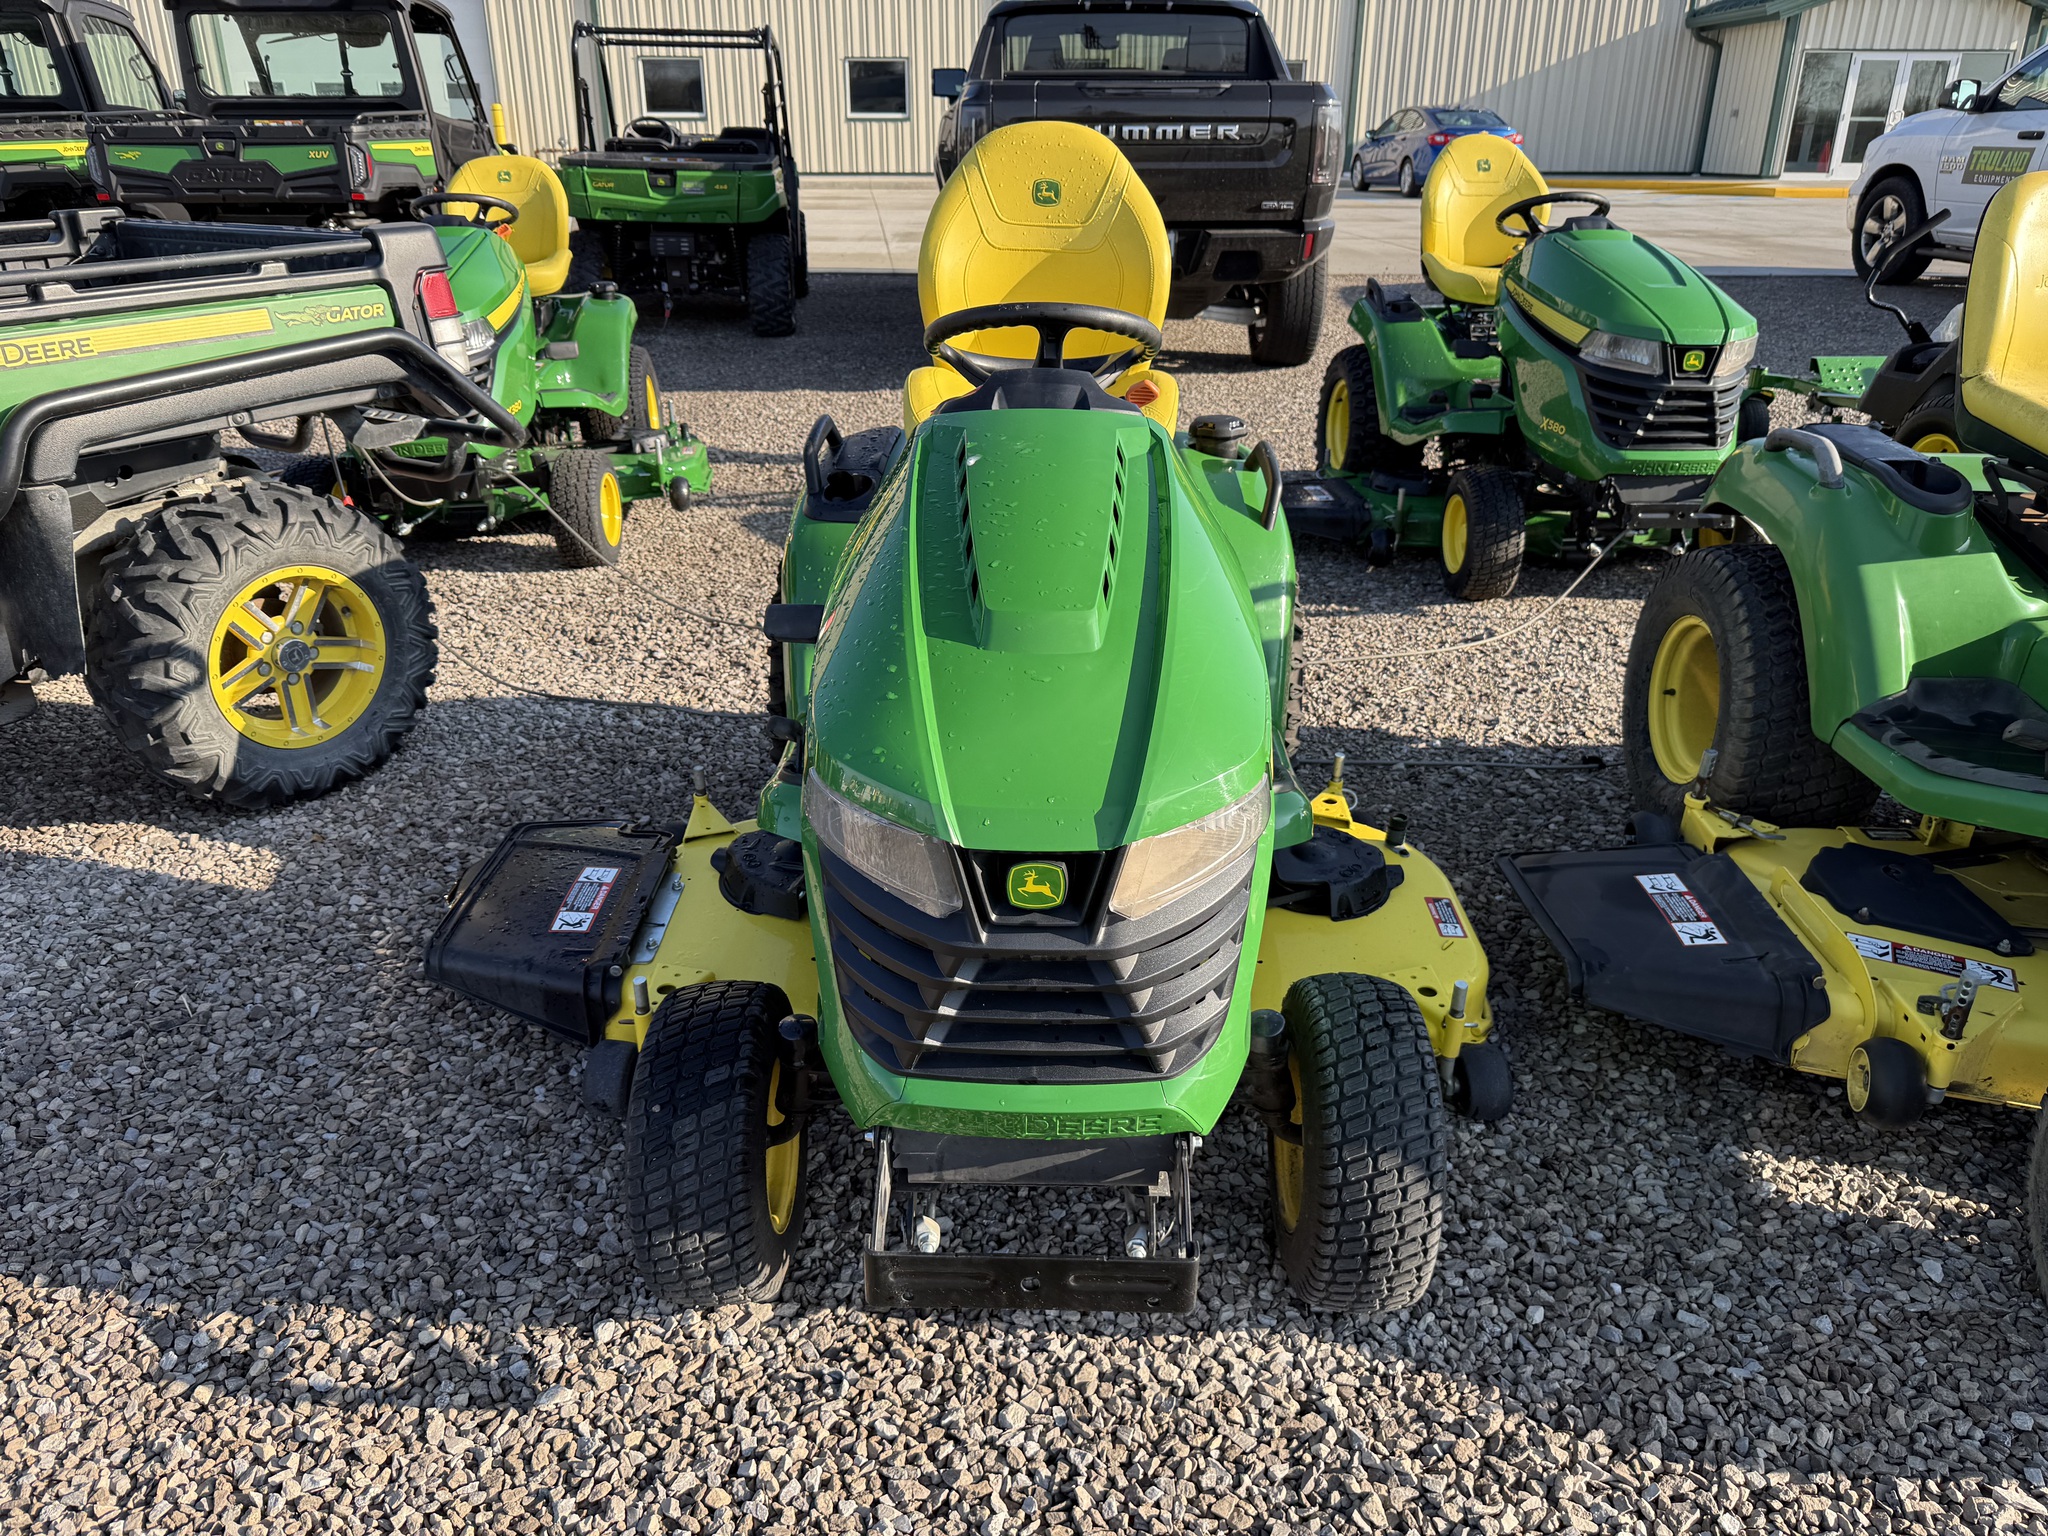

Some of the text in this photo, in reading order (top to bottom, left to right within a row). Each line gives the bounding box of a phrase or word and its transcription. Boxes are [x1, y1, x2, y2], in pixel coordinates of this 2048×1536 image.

[1094, 124, 1239, 140] UMMER
[308, 150, 329, 159] XUV
[1969, 150, 2030, 172] TRULAND
[326, 303, 385, 323] GATOR
[0, 337, 95, 364] DEERE
[1540, 416, 1566, 435] X580
[1912, 947, 1955, 960] DANGER
[1025, 1115, 1162, 1136] DEERE
